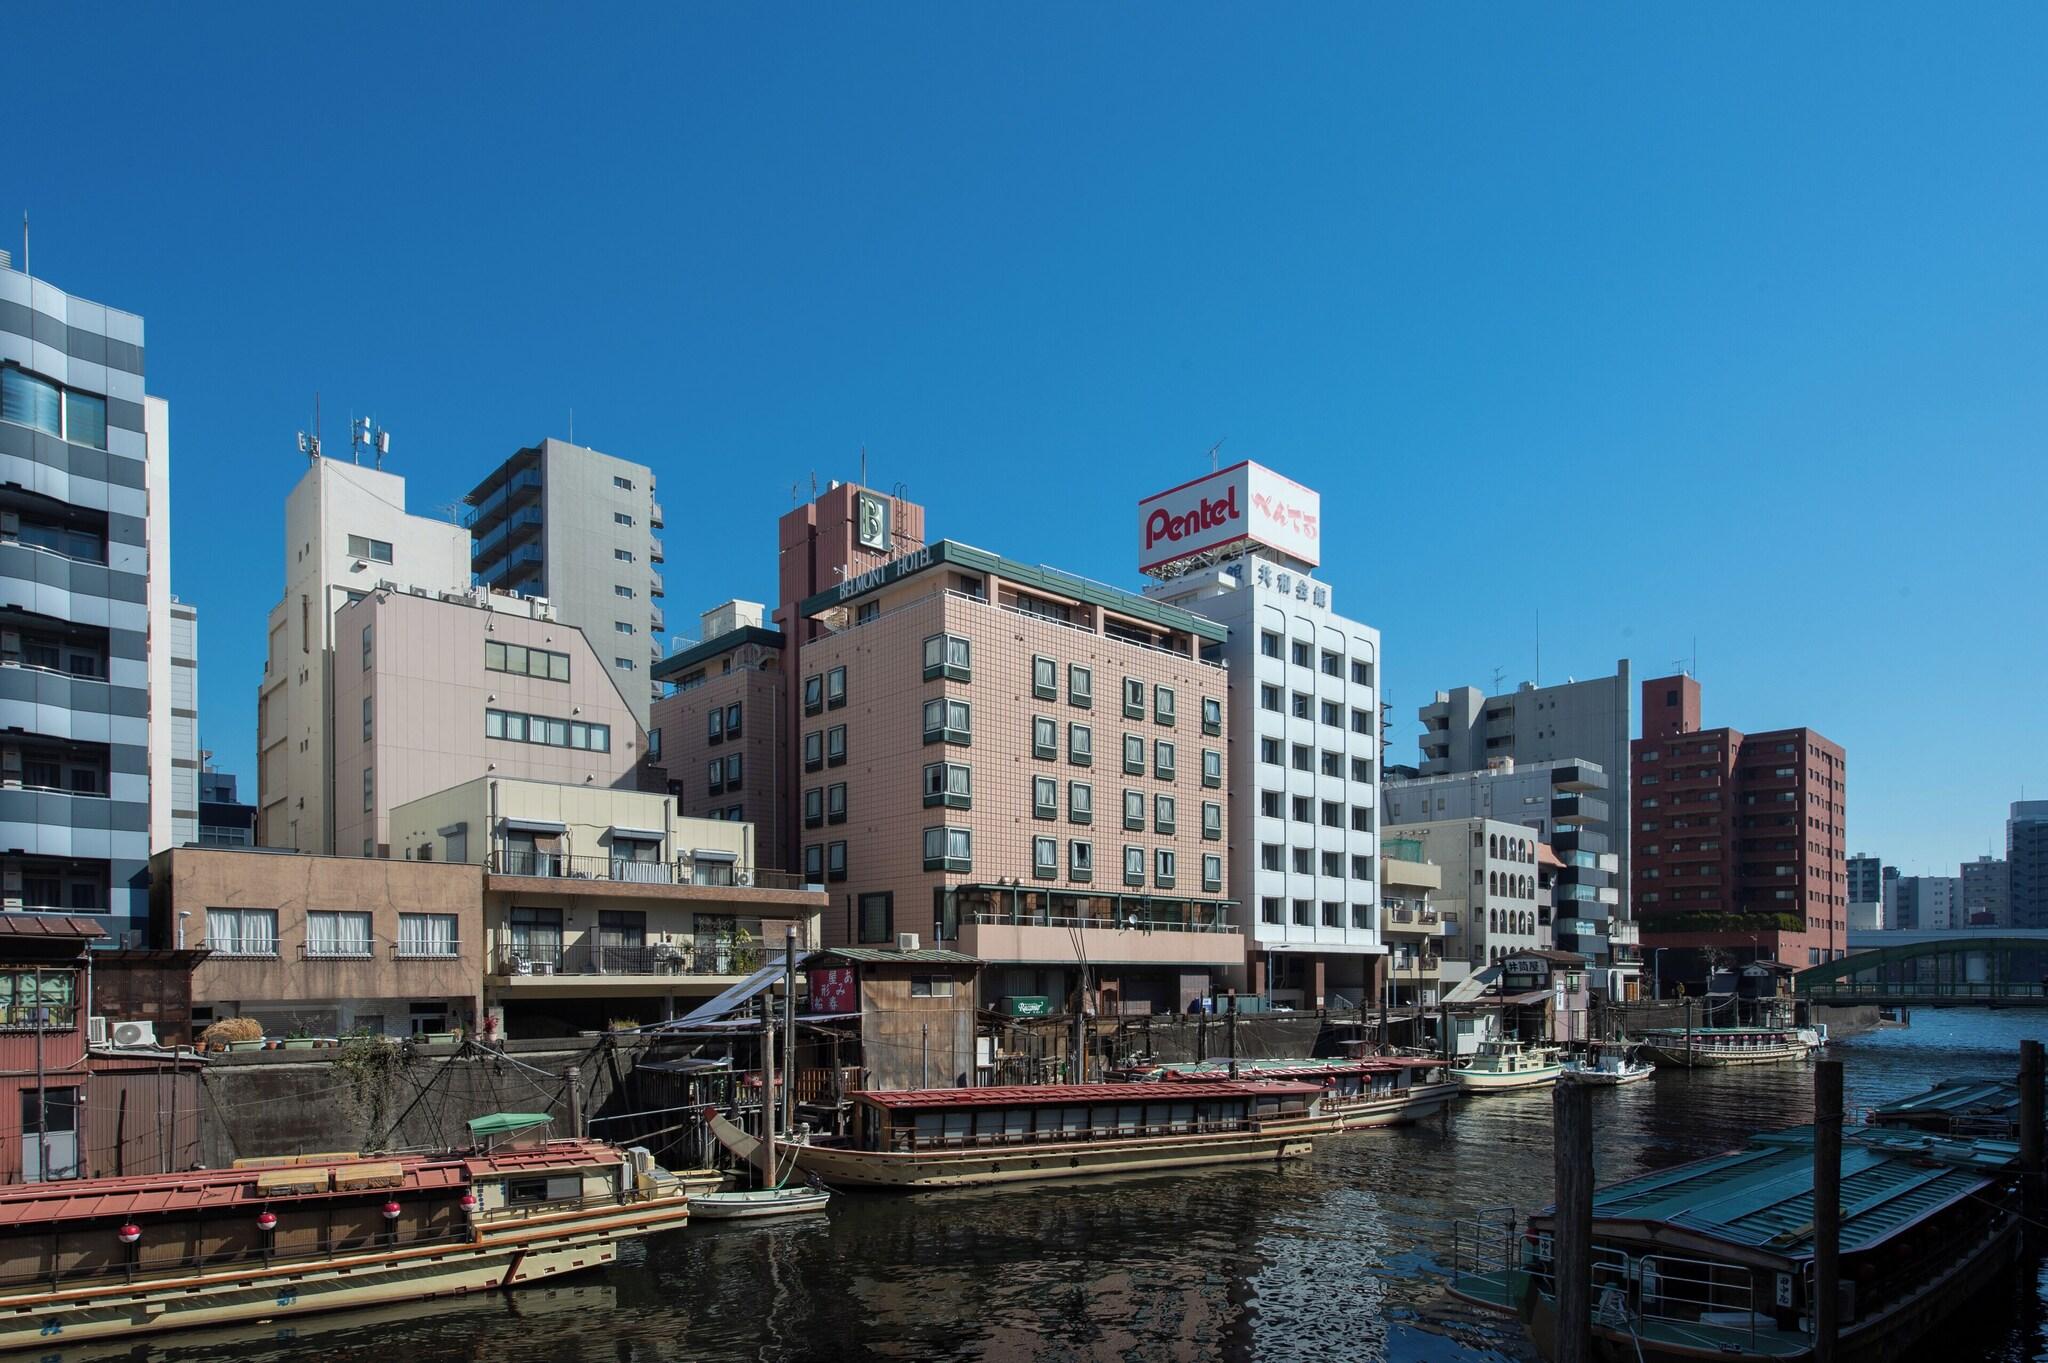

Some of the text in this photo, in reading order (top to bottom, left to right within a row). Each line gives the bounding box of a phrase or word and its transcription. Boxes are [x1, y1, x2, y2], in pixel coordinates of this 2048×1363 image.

[1146, 485, 1240, 549] Pentel
[839, 547, 934, 600] BELMONT HOTEL
[1508, 960, 1539, 972] 井筒屋
